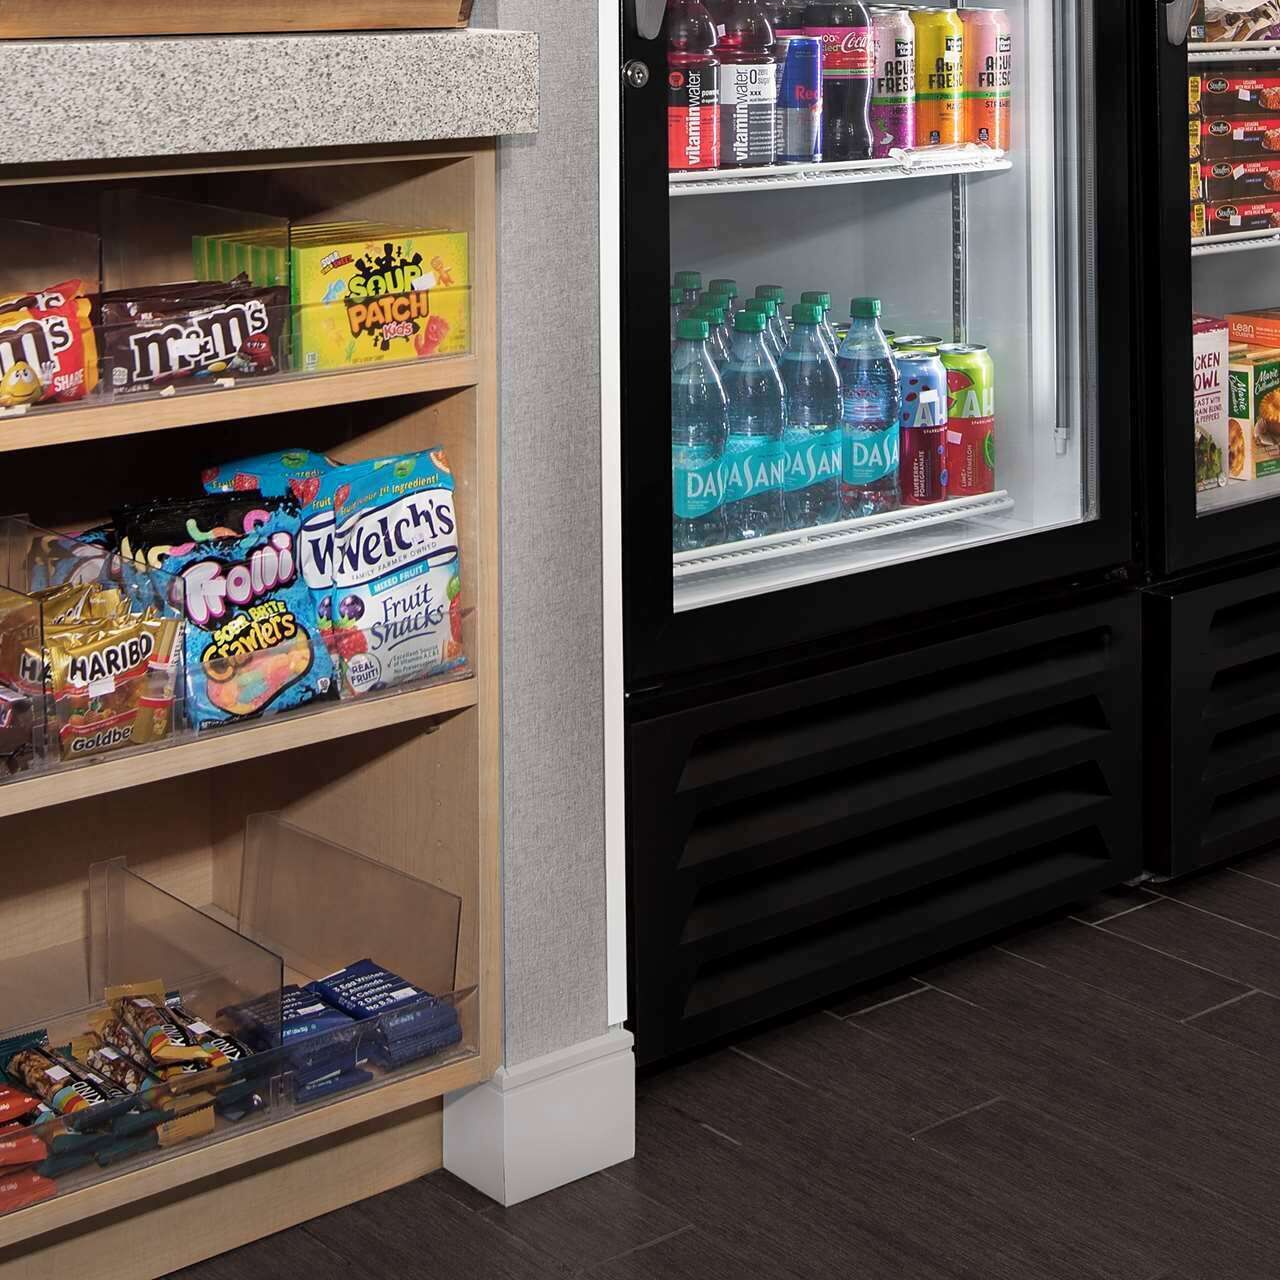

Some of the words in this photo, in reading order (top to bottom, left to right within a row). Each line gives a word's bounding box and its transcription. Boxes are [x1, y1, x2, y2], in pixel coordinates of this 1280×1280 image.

[685, 70, 701, 166] vitaminwater
[732, 68, 749, 162] vitaminwater
[349, 264, 422, 300] SOUR
[347, 291, 428, 334] PATCH
[383, 321, 413, 340] Kids
[1232, 322, 1254, 333] Lean
[54, 369, 85, 392] SHARE
[334, 498, 456, 575] Welch's
[183, 532, 296, 623] Trolli
[399, 565, 424, 583] FRUIT
[382, 583, 434, 623] Fruit
[202, 610, 297, 670] Crawlers
[370, 603, 445, 651] Snacks
[70, 630, 156, 684] HARIBO
[350, 667, 379, 687] FRUIT!
[351, 660, 374, 674] REAL
